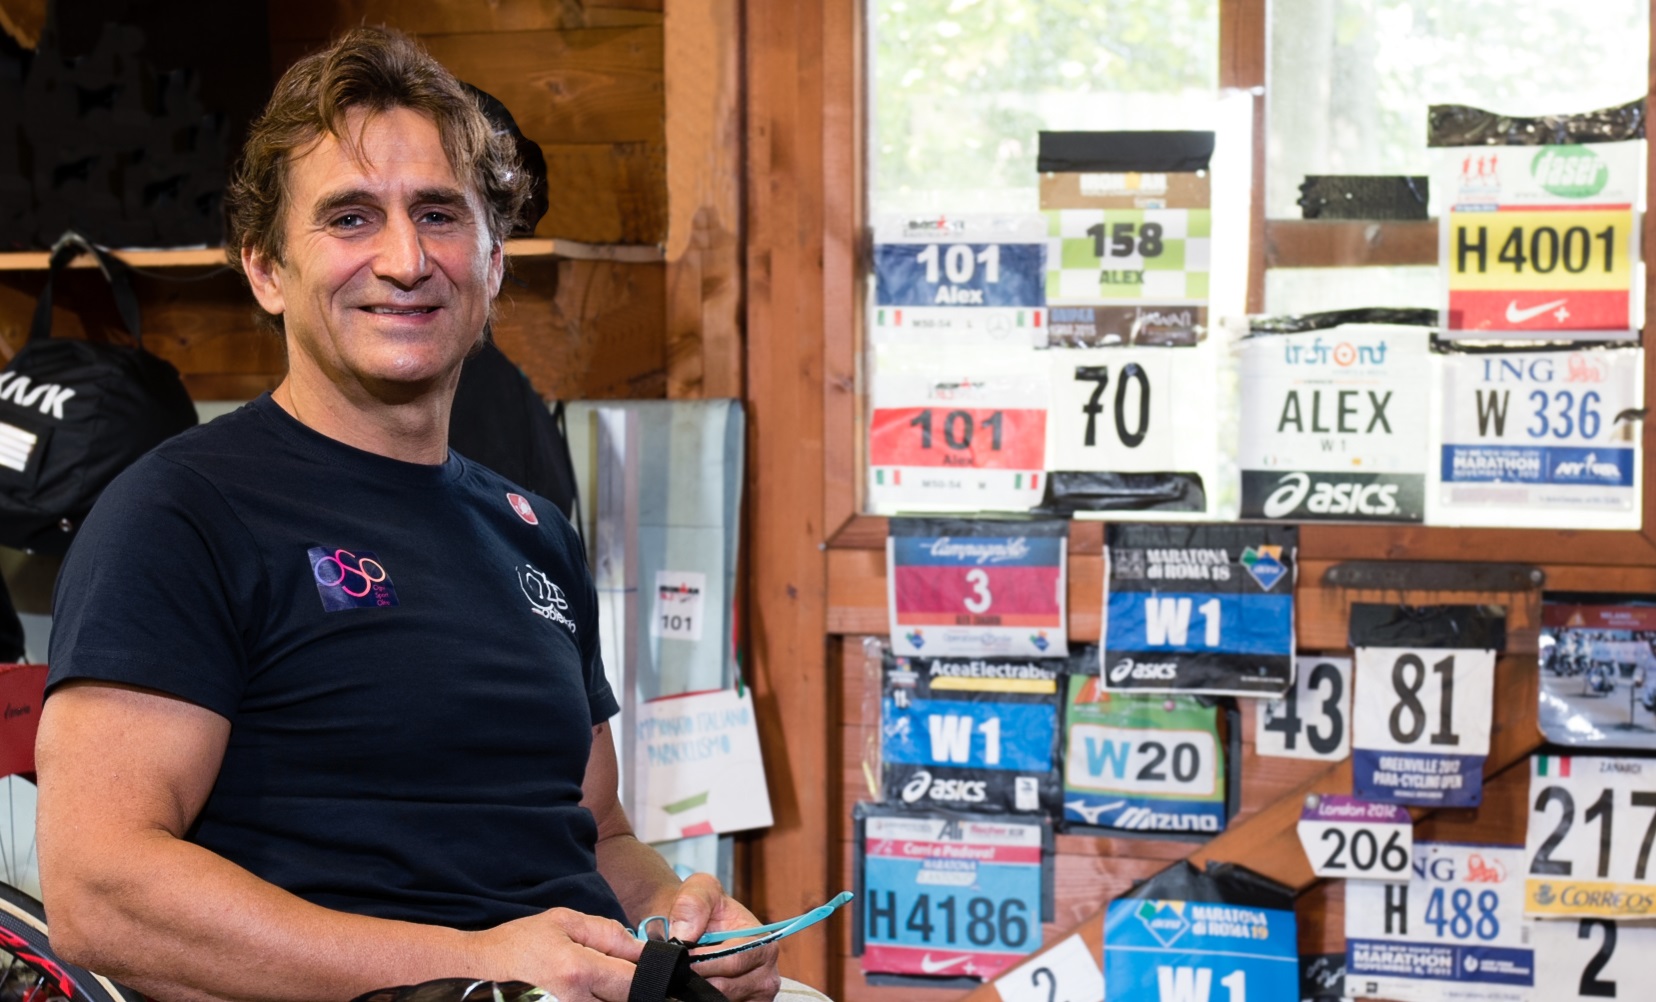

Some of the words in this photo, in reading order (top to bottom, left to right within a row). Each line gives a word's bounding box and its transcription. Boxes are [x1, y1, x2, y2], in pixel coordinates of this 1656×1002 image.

[1086, 222, 1164, 258] 158
[1457, 226, 1487, 273] H
[1498, 225, 1615, 273] 4001
[917, 244, 1000, 283] 101
[1099, 270, 1145, 284] ALEX
[935, 285, 983, 304] Alex
[1483, 358, 1555, 382] ING
[1075, 363, 1150, 448] 70
[1277, 390, 1393, 434] ALEX
[1475, 390, 1510, 437] W
[1527, 390, 1602, 439] 336
[910, 409, 1003, 451] 101
[943, 455, 974, 466] Alex
[1453, 457, 1540, 472] MARATHON
[1307, 480, 1399, 516] asics
[1147, 549, 1229, 564] MARATONA
[1147, 564, 1162, 579] di
[1165, 565, 1209, 580] ROMA
[1211, 566, 1231, 581] 18
[964, 569, 992, 613] 3
[661, 614, 692, 632] 101
[1131, 663, 1177, 680] asics
[1264, 663, 1343, 754] 43
[1389, 652, 1459, 746] 81
[928, 714, 1000, 765] W1
[1379, 756, 1438, 773] GREENVILLE
[929, 778, 988, 802] asics
[1373, 772, 1440, 789] PARA-CYCLING
[1441, 775, 1462, 789] OPEN
[1318, 801, 1366, 816] London
[1367, 803, 1397, 819] 2012
[1529, 786, 1656, 880] 217
[1319, 827, 1408, 873] 206
[1413, 858, 1456, 881] NG
[1560, 886, 1656, 908] CORREOS
[868, 889, 898, 940] H
[907, 893, 1028, 948] 4186
[1191, 906, 1268, 925] MARATONA
[1384, 883, 1408, 934] H
[1425, 886, 1499, 940] 488
[1208, 921, 1250, 938] ROMA
[1251, 926, 1269, 940] 19
[1353, 950, 1452, 968] MARATHON
[1353, 962, 1412, 973] NOVEMBER
[1578, 918, 1617, 998] 2
